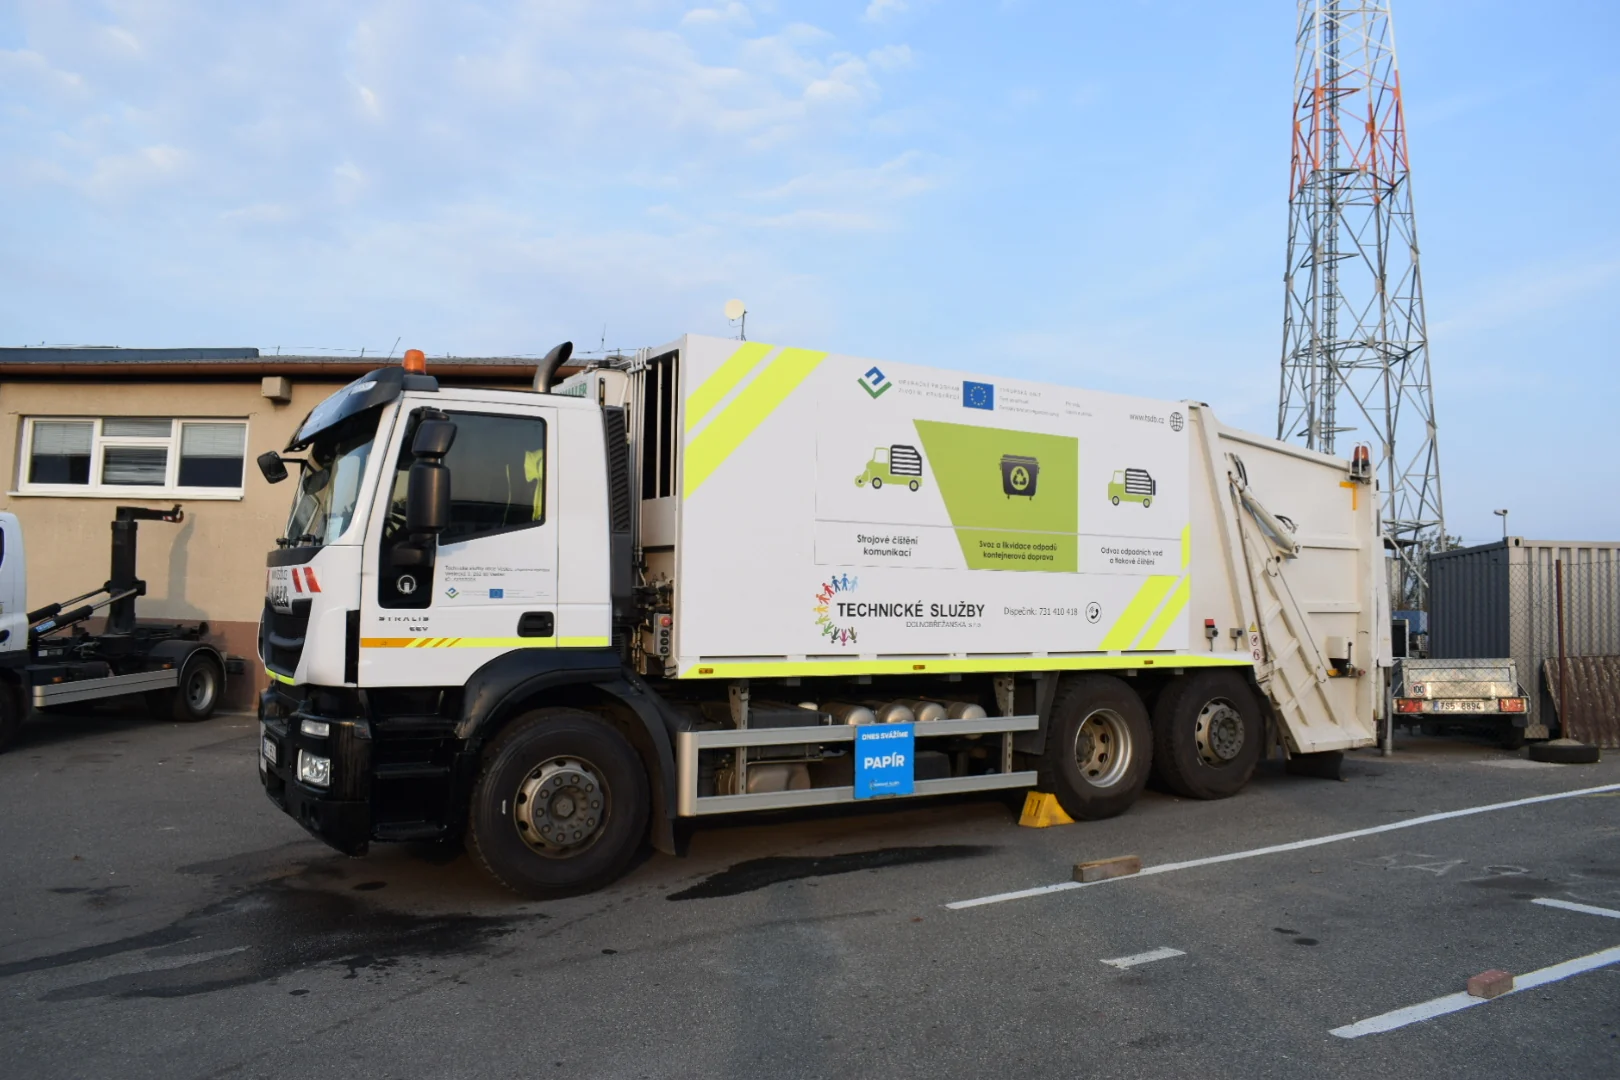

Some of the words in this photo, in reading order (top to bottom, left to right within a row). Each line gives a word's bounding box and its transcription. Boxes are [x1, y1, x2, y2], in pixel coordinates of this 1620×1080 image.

[857, 534, 890, 545] Strojové
[892, 535, 919, 545] čištění
[979, 540, 994, 549] Svoz
[1002, 541, 1031, 550] likvidace
[1033, 542, 1057, 551] odpadů
[863, 547, 912, 556] komunikací
[983, 551, 1026, 560] kontejnerová
[1027, 553, 1053, 562] doprava
[837, 599, 924, 618] TECHNICKÉ
[930, 601, 985, 618] SLUŽBY
[1003, 606, 1037, 617] Dispečink:
[1039, 607, 1050, 616] 731
[1053, 607, 1064, 616] 410
[1066, 607, 1078, 616] 418
[1413, 685, 1424, 694] 100
[880, 730, 909, 739] SVÁŽÍME
[864, 752, 905, 770] PAPÍR
